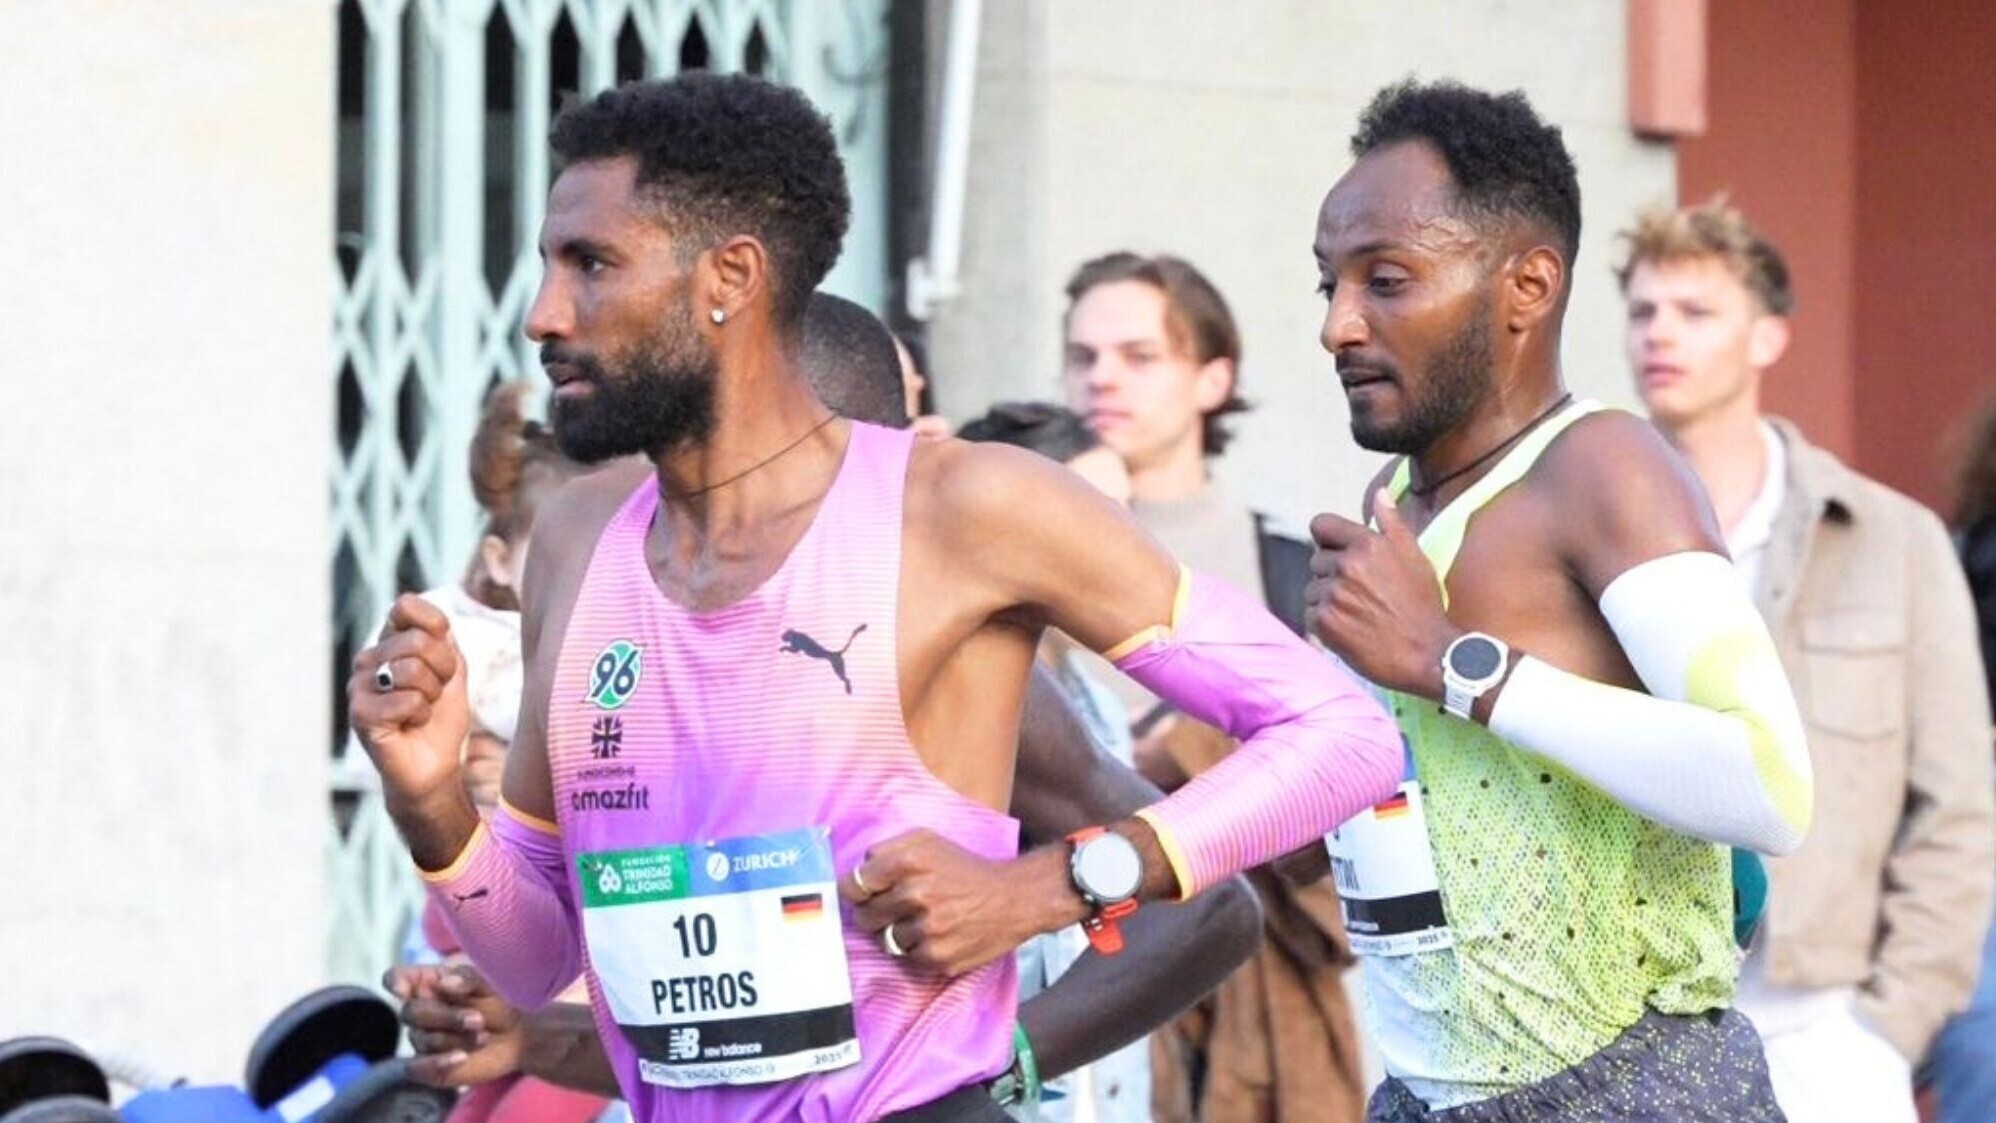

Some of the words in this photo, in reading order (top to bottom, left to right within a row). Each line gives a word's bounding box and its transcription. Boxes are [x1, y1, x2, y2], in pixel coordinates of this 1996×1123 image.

[590, 649, 638, 697] 96
[571, 782, 649, 812] amazfit
[622, 865, 671, 880] TRINIDAD
[732, 849, 798, 873] ZURICH
[624, 880, 673, 895] ALFONSO
[673, 912, 718, 958] 10
[651, 970, 758, 1015] PETROS
[722, 1042, 762, 1056] balance
